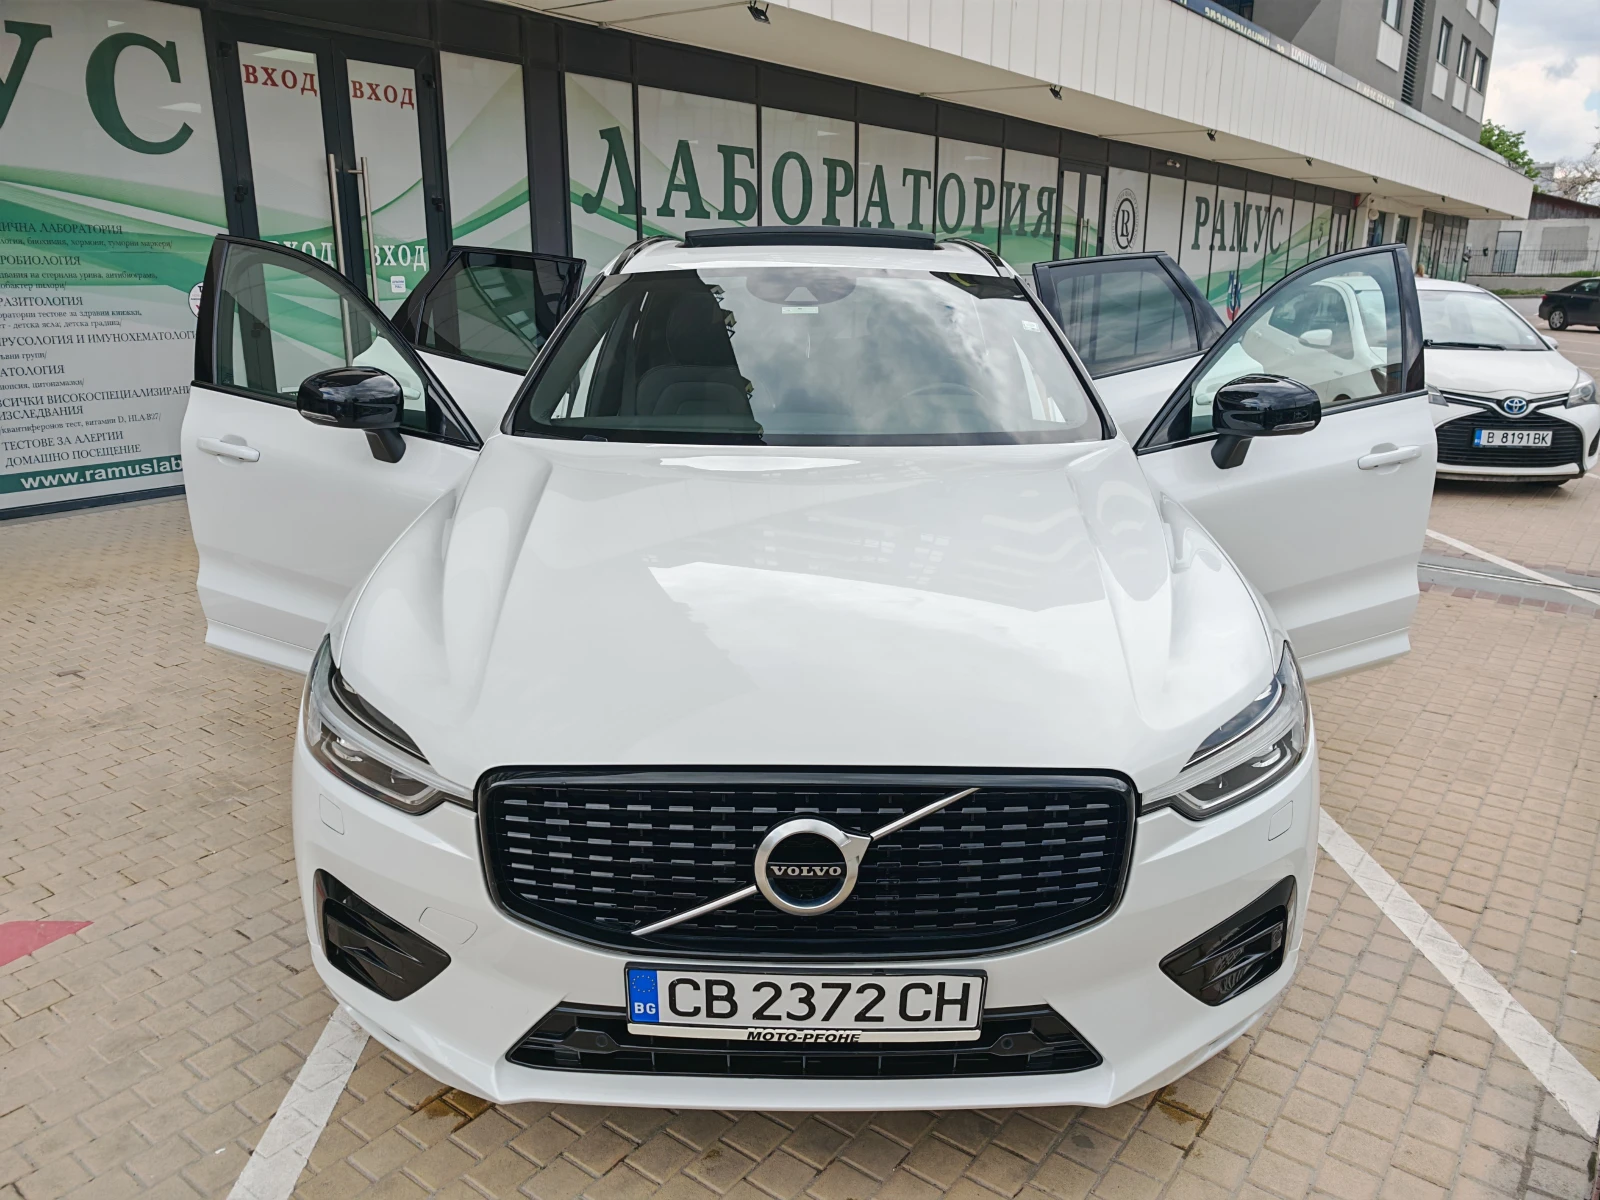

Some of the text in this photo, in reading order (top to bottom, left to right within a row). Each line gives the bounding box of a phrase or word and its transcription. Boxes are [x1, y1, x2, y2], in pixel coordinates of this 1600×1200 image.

[242, 63, 319, 97] ВХОД
[351, 79, 415, 110] ВХОД
[581, 125, 1057, 239] ЛАБОРАТОРИЯ
[39, 223, 123, 235] ЛАБОРАТОРИЯ
[1190, 195, 1285, 255] РАМУС
[76, 334, 85, 344] И
[0, 405, 84, 421] ИЗСЛЕДВАНИЯ
[2, 430, 124, 451] ТЕСТОВЕ ЗА АЛЕРГИИ
[1486, 431, 1495, 443] B
[5, 444, 142, 468] ДОМАШНО ПОСЕЩЕНИЕ
[20, 456, 183, 489] www.ramuslab
[769, 865, 842, 877] VOLVO
[634, 1002, 657, 1015] BG
[752, 981, 886, 1022] 2372
